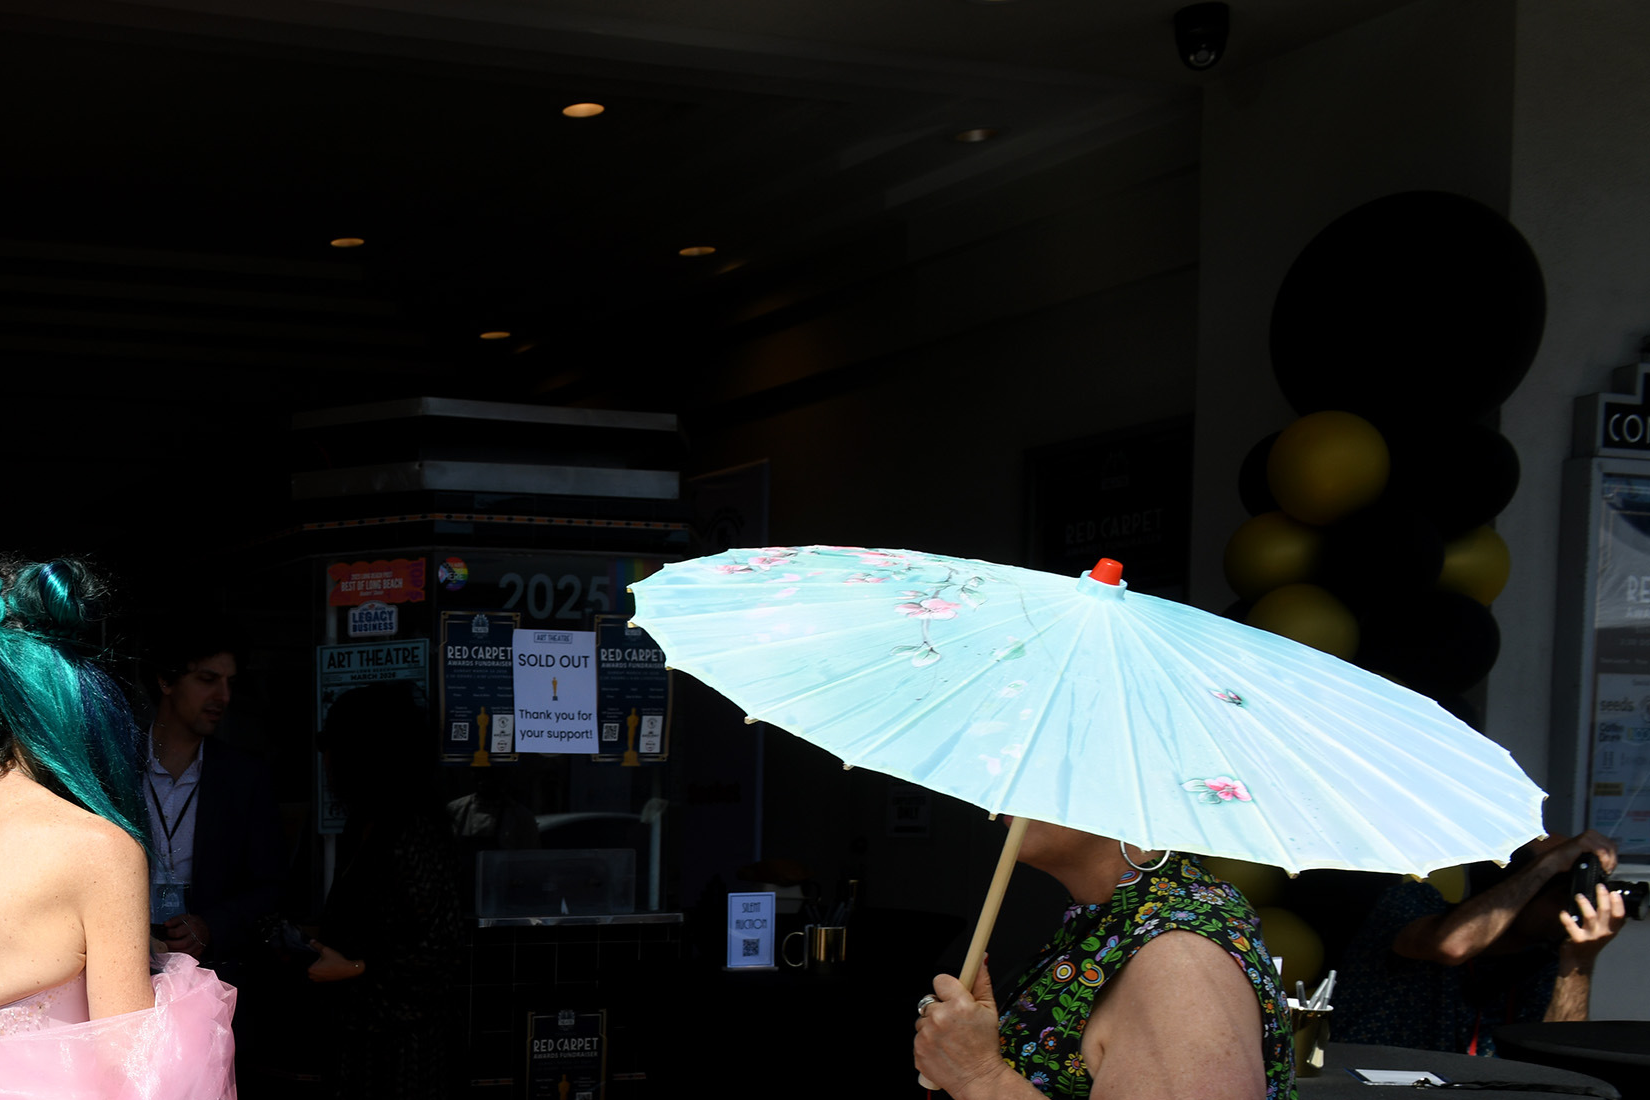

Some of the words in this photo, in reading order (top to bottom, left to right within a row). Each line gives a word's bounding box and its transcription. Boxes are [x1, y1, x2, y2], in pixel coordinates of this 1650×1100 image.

[1609, 413, 1650, 444] CO
[341, 580, 356, 592] BEST
[357, 580, 365, 591] OF
[365, 579, 382, 591] LONG
[383, 577, 404, 590] BEACH
[497, 572, 610, 620] 2025
[352, 610, 394, 623] LEGACY
[352, 622, 394, 633] BUSINESS
[548, 634, 571, 642] THEATRE
[327, 651, 354, 669] ART
[357, 646, 421, 667] THEATRE
[447, 645, 470, 659] RED
[471, 646, 513, 660] CARPET
[600, 648, 623, 661] RED
[518, 653, 556, 667] SOLD
[559, 655, 590, 668] OUT
[351, 673, 378, 681] MARCH
[519, 709, 552, 720] Thank
[554, 712, 575, 723] you
[578, 710, 593, 721] for
[520, 729, 545, 741] your
[547, 729, 593, 742] support!
[533, 1039, 555, 1053] RED
[556, 1037, 599, 1051] CARPET
